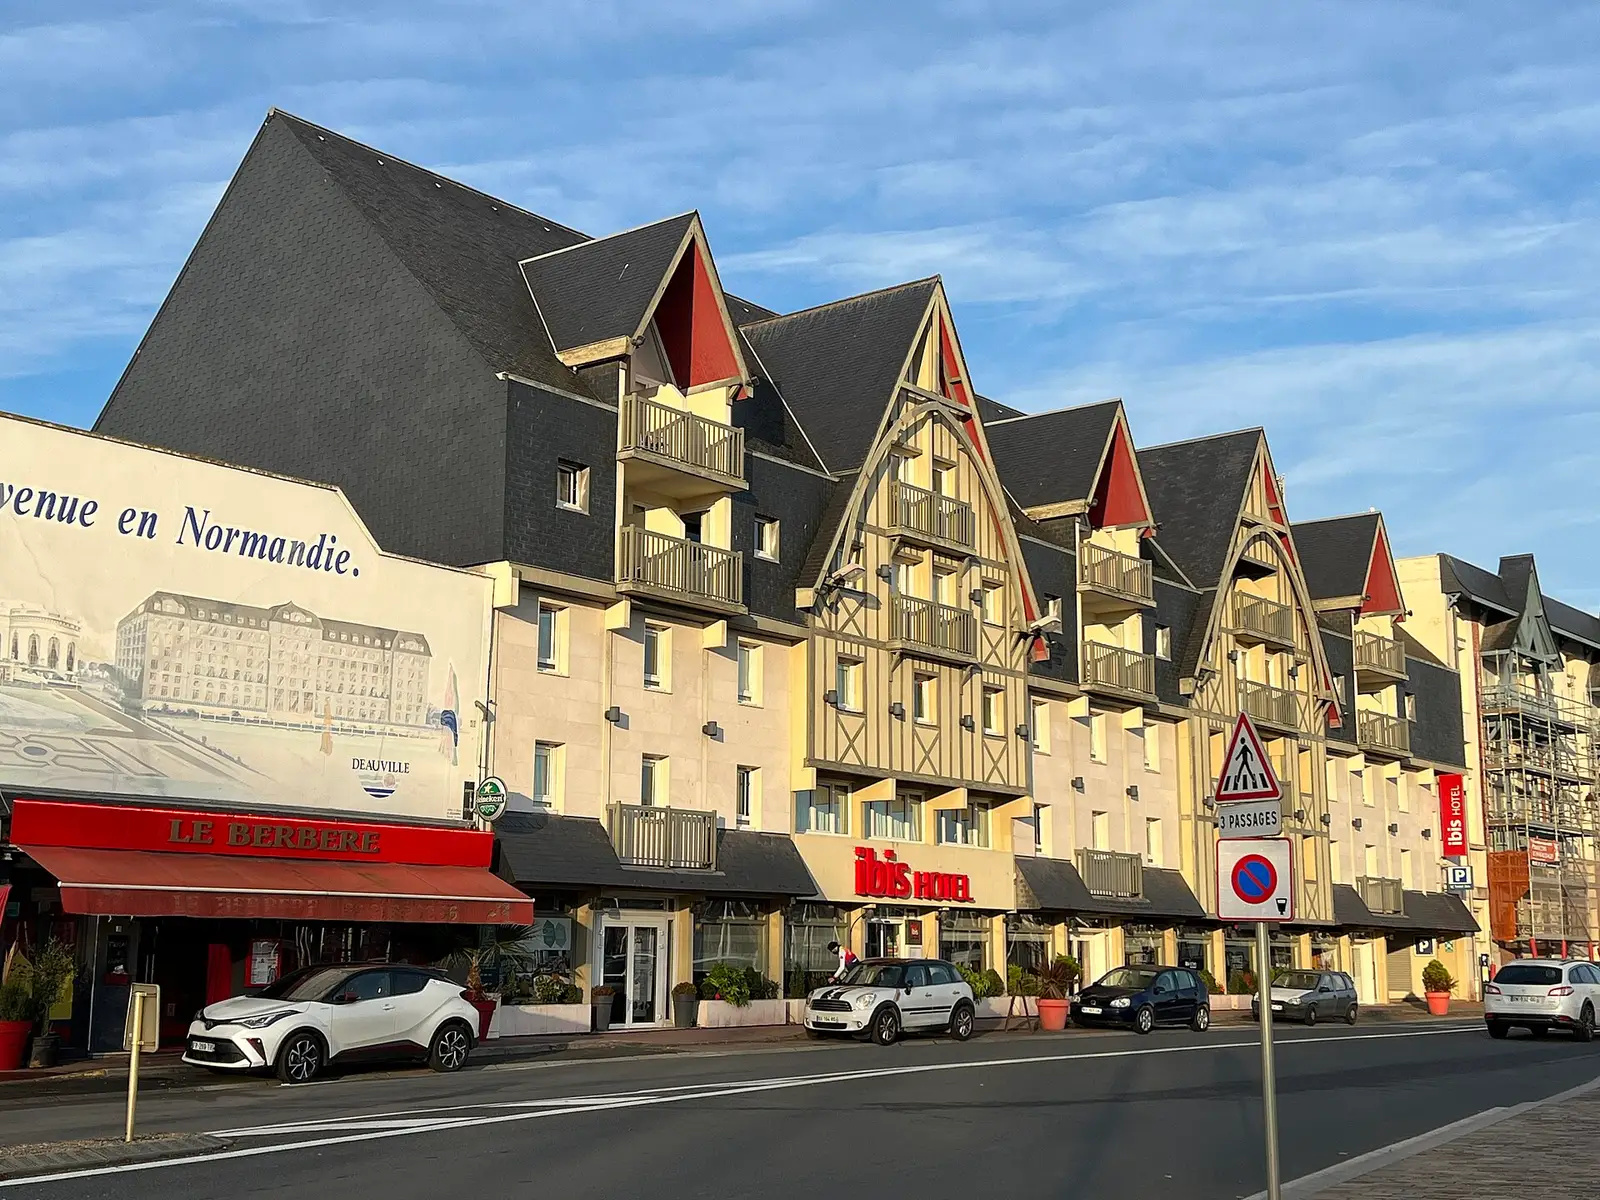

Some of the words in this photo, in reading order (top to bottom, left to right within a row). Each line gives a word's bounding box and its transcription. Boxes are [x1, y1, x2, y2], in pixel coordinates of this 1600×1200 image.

[0, 483, 98, 528] venue
[118, 508, 158, 539] en
[176, 505, 360, 578] Normandie.
[352, 758, 410, 773] DEAUVILLE
[1451, 784, 1461, 816] HOTEL
[1220, 815, 1226, 829] 3
[1229, 810, 1278, 829] PASSAGES
[1447, 819, 1463, 846] ibis
[167, 819, 213, 845] LE
[226, 822, 380, 853] BERBERE
[855, 846, 911, 899] ibis
[914, 870, 976, 903] HOTEL
[1454, 869, 1466, 882] P
